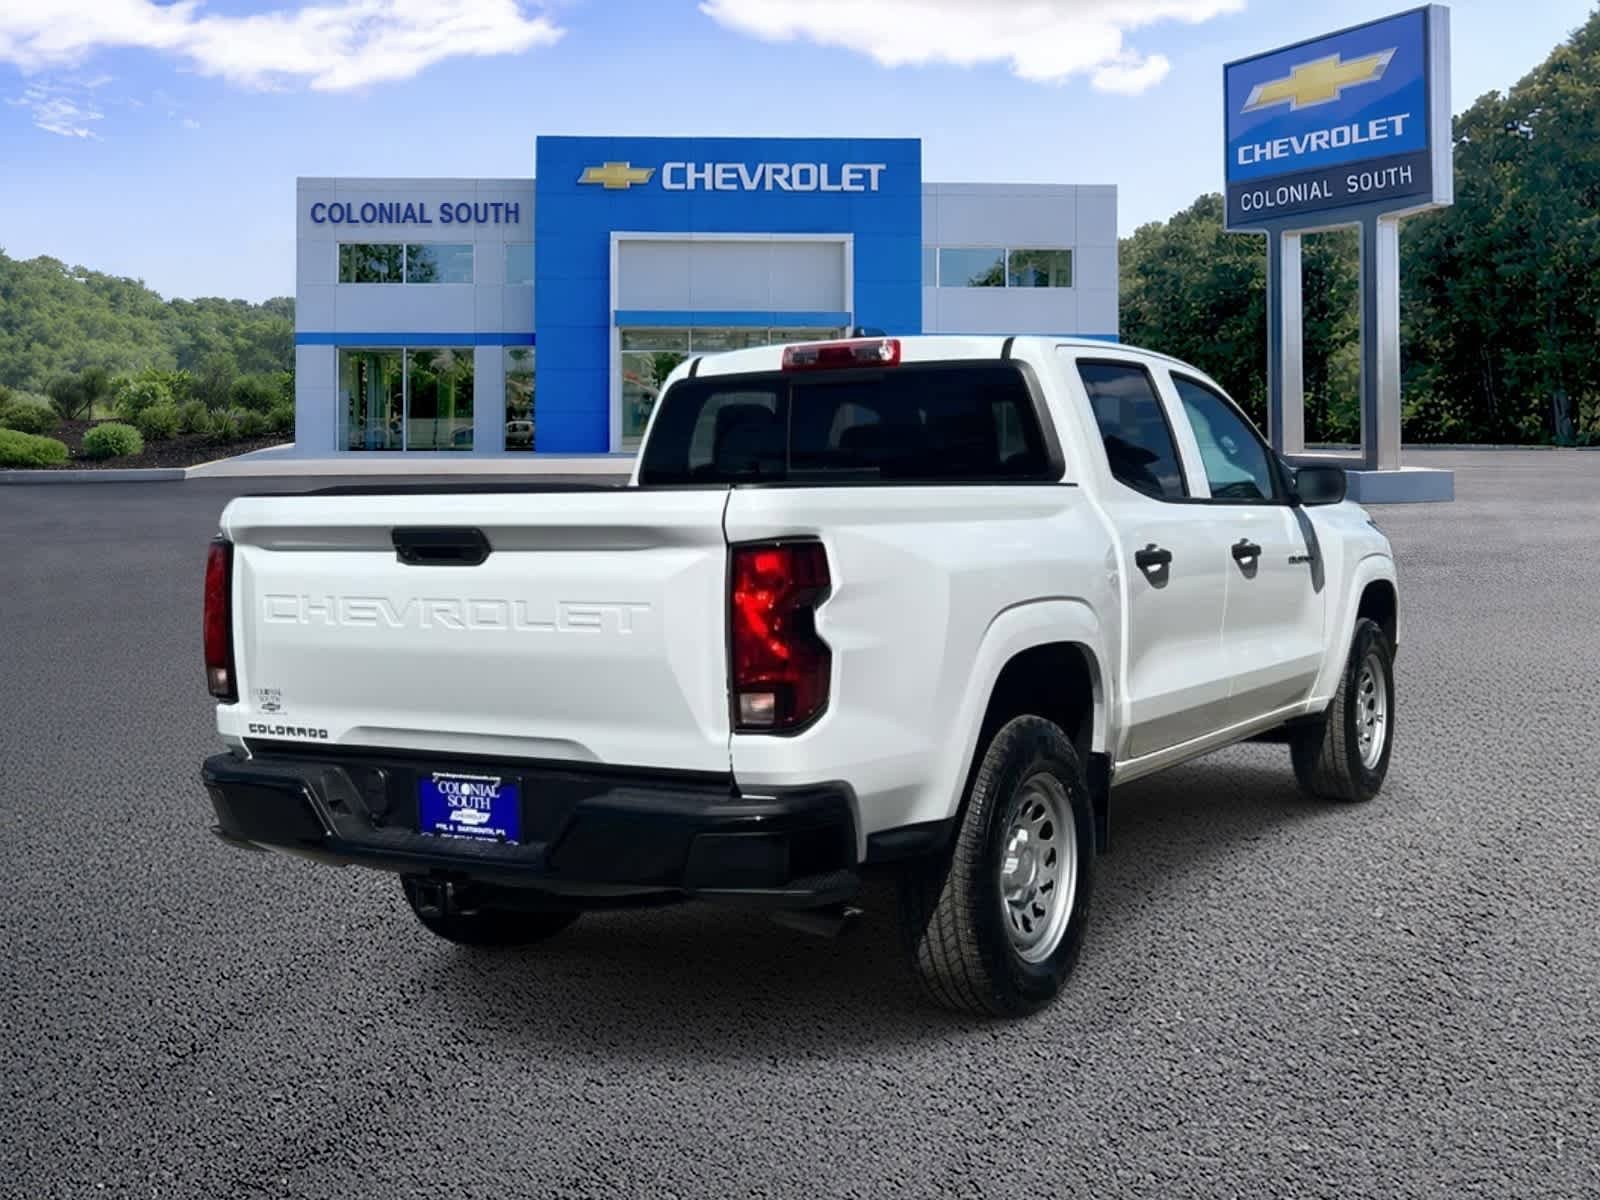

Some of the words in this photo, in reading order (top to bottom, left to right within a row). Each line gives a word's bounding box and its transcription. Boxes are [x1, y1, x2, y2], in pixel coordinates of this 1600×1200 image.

[1238, 113, 1410, 165] CHEVROLET
[661, 161, 887, 193] CHEVROLET
[1240, 180, 1333, 211] COLONIAL
[1347, 165, 1413, 193] SOUTH
[310, 202, 433, 225] COLONIAL
[439, 202, 521, 225] SOUTH
[263, 594, 652, 635] CHEVROLET
[248, 723, 329, 739] COLORADO
[437, 780, 500, 798] COLONIAL
[447, 794, 491, 810] SOUTH
